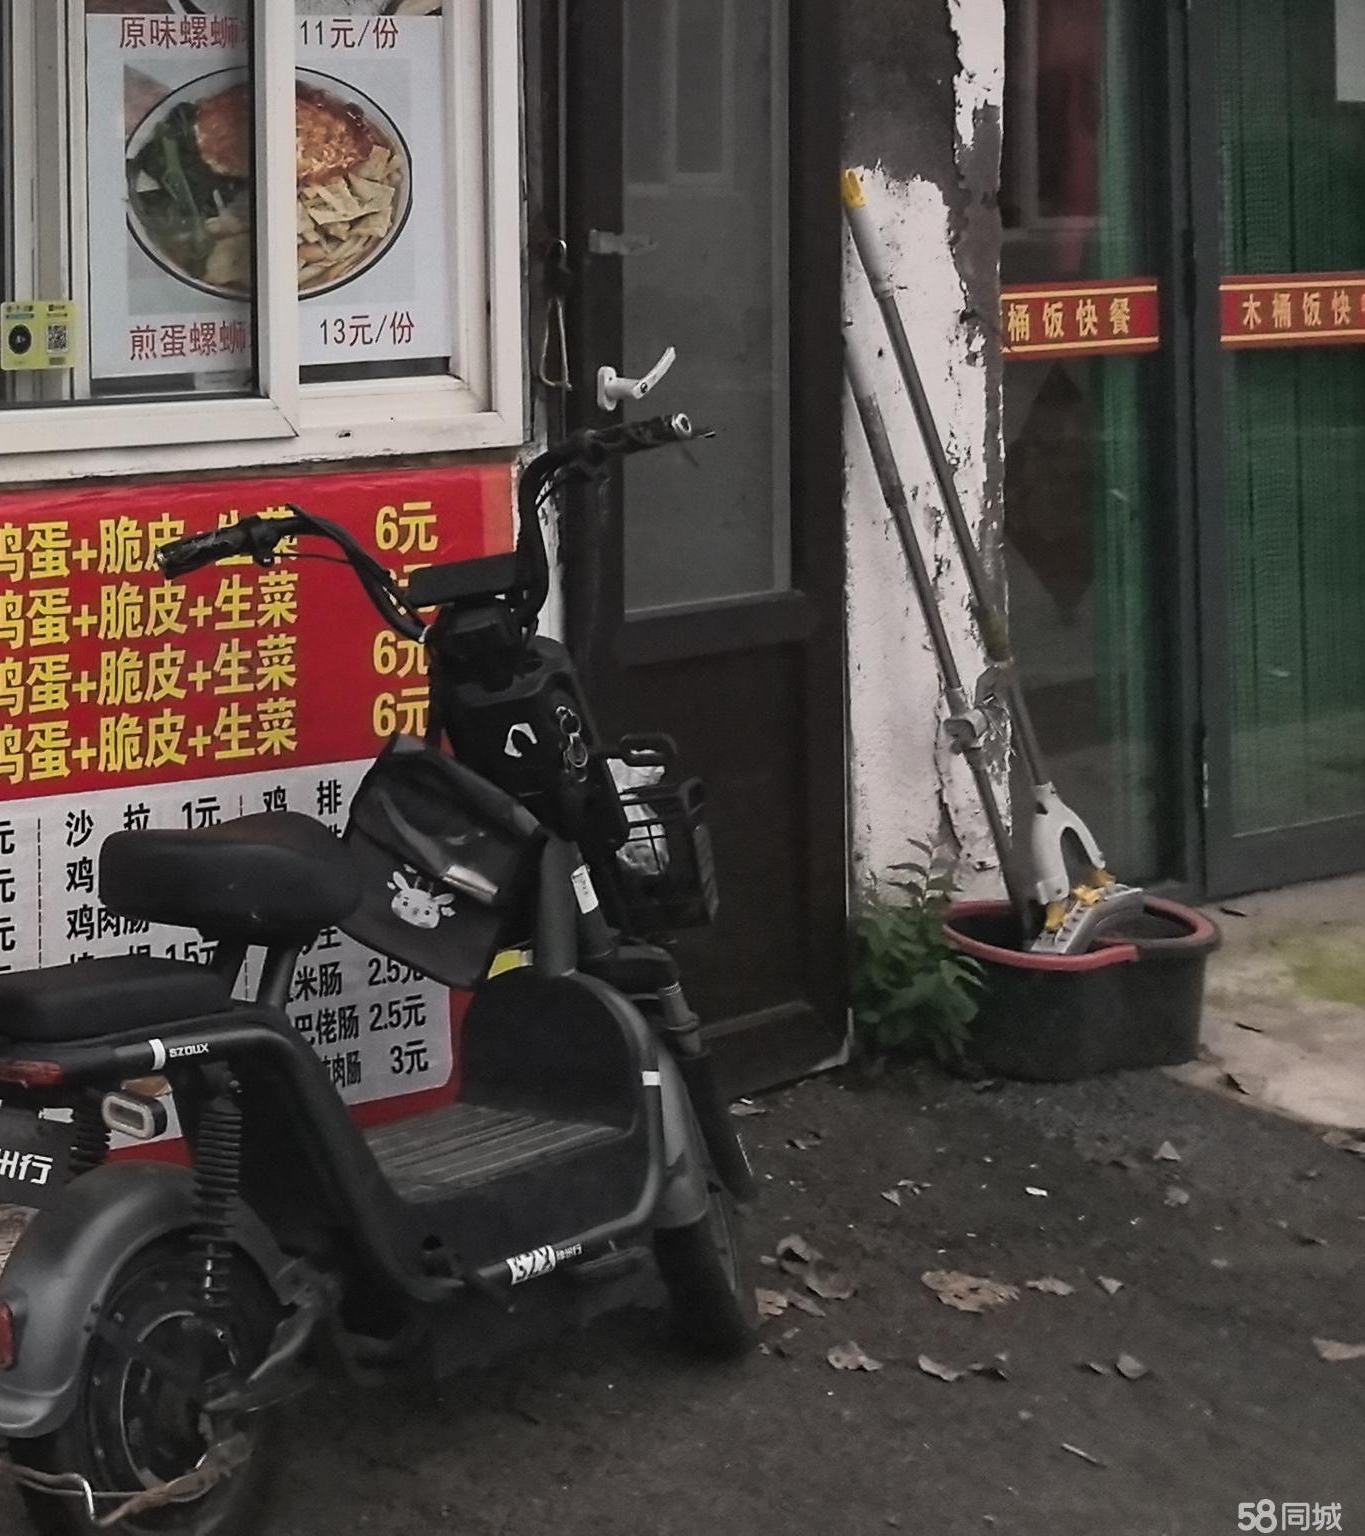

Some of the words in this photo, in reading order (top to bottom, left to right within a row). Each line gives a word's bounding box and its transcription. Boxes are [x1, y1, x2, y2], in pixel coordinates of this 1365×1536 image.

[119, 16, 244, 49] 原味螺蛳
[300, 18, 399, 49] 11元/份
[1242, 290, 1365, 330] 木桶饭快
[129, 323, 246, 361] 煎蛋螺蛳
[319, 312, 414, 347] 13元/份
[375, 501, 438, 554] 6元
[373, 687, 430, 737] 6元
[369, 994, 426, 1031] 2.5元
[390, 1039, 429, 1075] 3元
